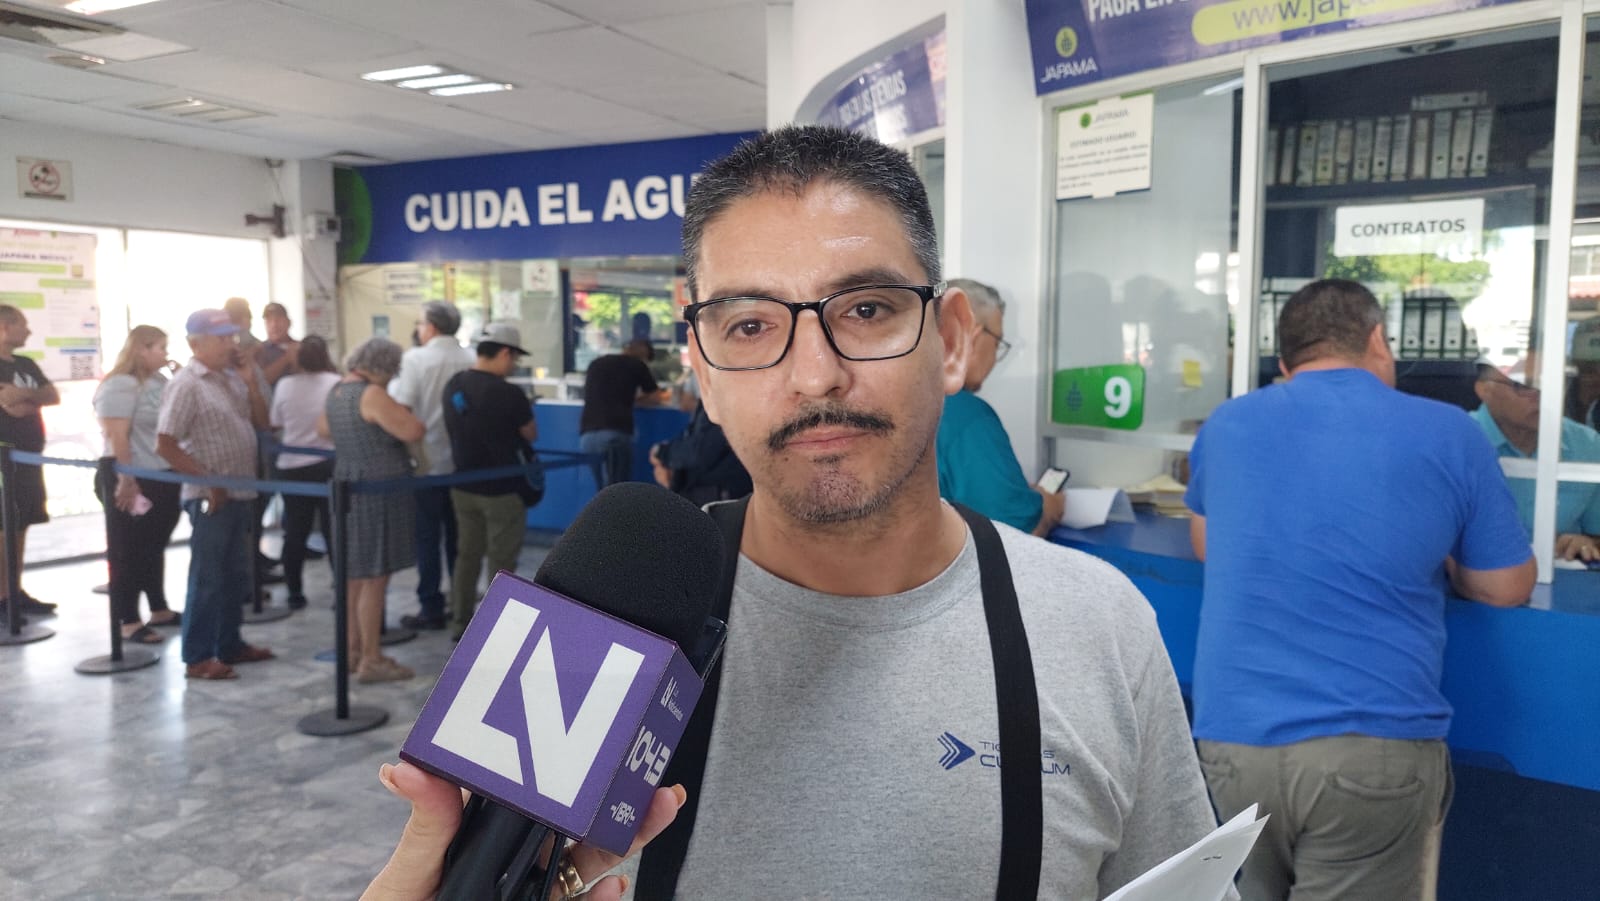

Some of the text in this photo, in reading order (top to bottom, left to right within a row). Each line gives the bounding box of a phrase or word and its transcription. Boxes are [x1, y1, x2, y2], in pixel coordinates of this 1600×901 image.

[1041, 58, 1097, 83] JAPAMA
[405, 187, 531, 232] CUIDA
[537, 183, 594, 225] EL
[1351, 218, 1466, 238] CONTRATOS
[1104, 376, 1132, 418] 9
